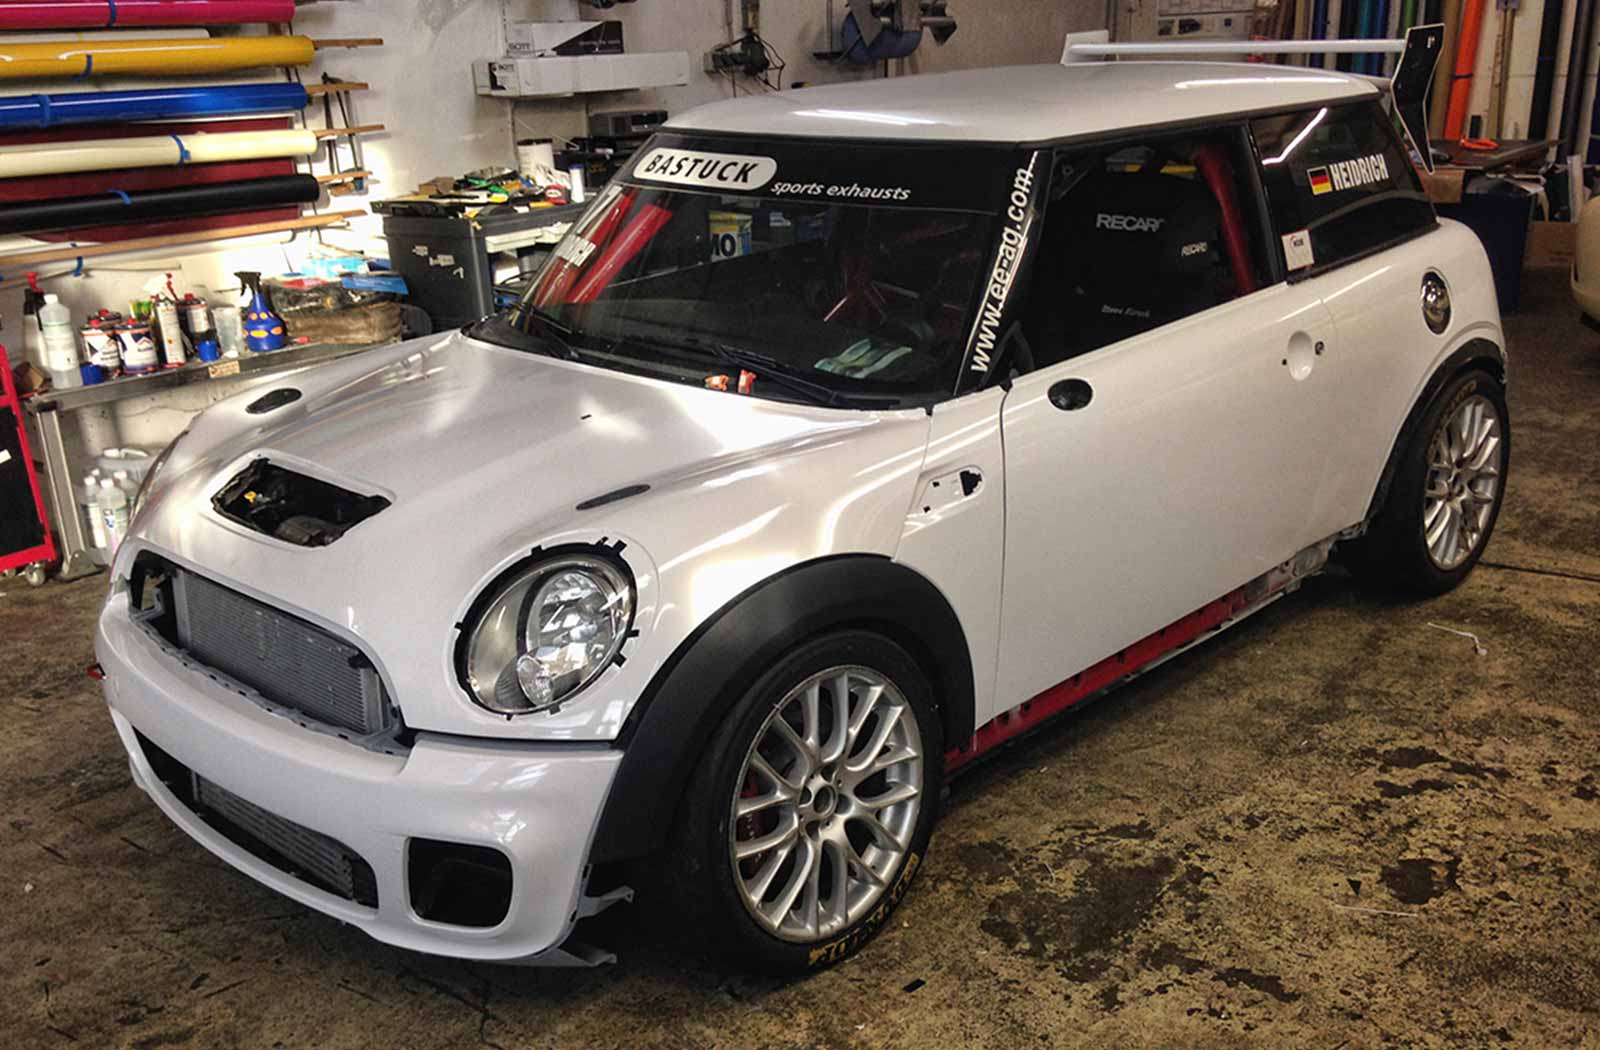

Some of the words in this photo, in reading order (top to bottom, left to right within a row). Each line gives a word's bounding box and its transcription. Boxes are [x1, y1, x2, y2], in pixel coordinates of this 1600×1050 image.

[644, 154, 758, 183] BASTUCK
[1329, 153, 1390, 191] HEIDRICH
[770, 181, 825, 196] sports
[826, 183, 912, 201] exhausts
[1096, 213, 1165, 232] RECAR
[971, 168, 1034, 372] www.ee-ag.com
